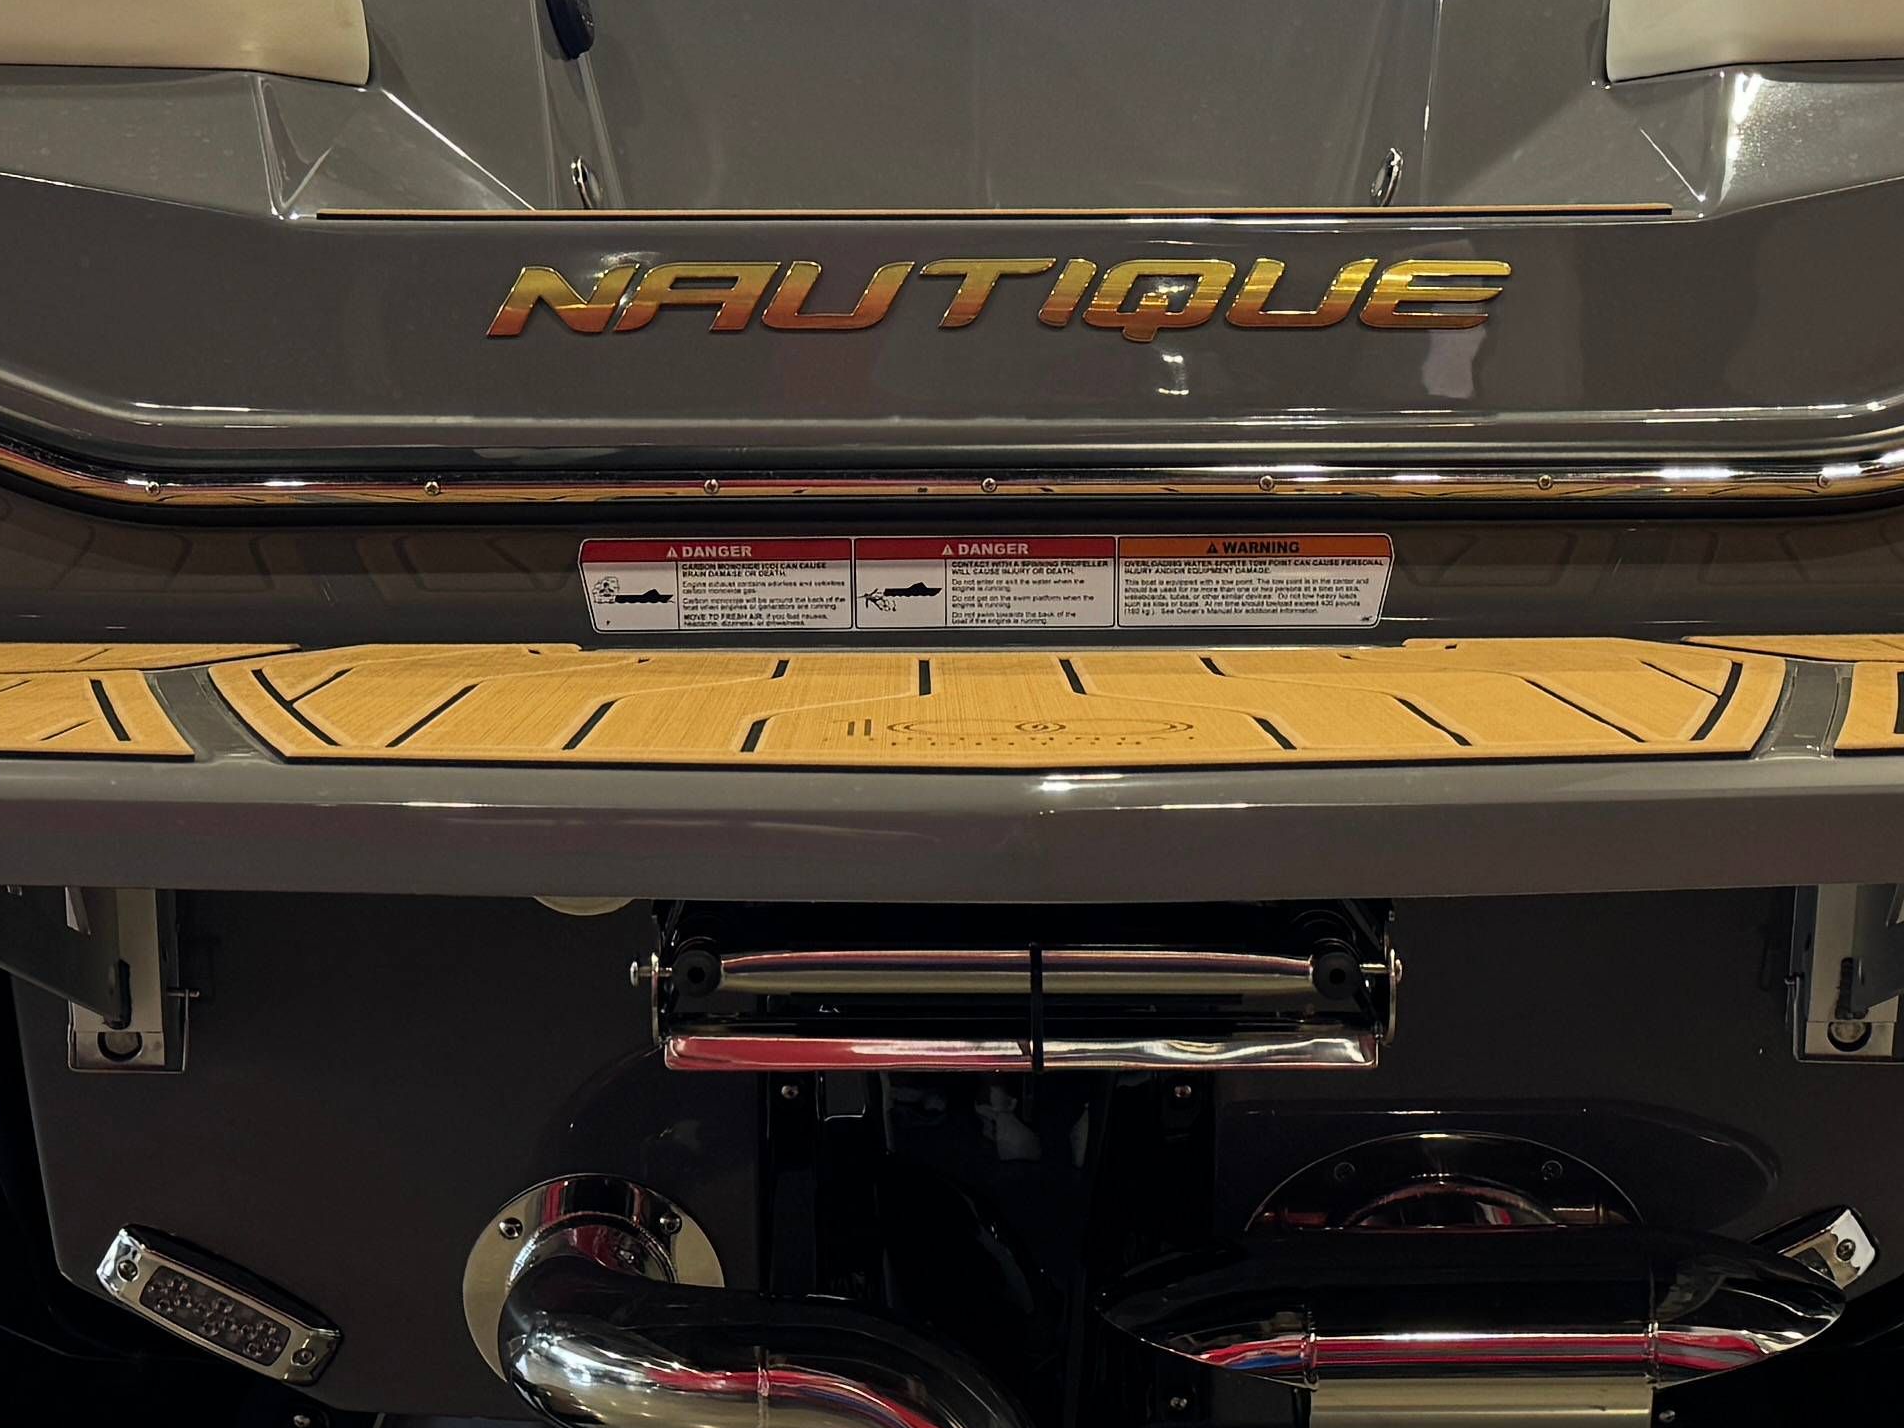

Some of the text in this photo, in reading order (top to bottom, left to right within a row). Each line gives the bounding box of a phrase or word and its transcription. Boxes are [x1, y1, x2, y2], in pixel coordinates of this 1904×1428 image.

[485, 256, 1512, 342] NAUTIQUE
[682, 545, 752, 557] DANGER
[958, 543, 1029, 555] DANGER
[1223, 541, 1300, 554] WARNING
